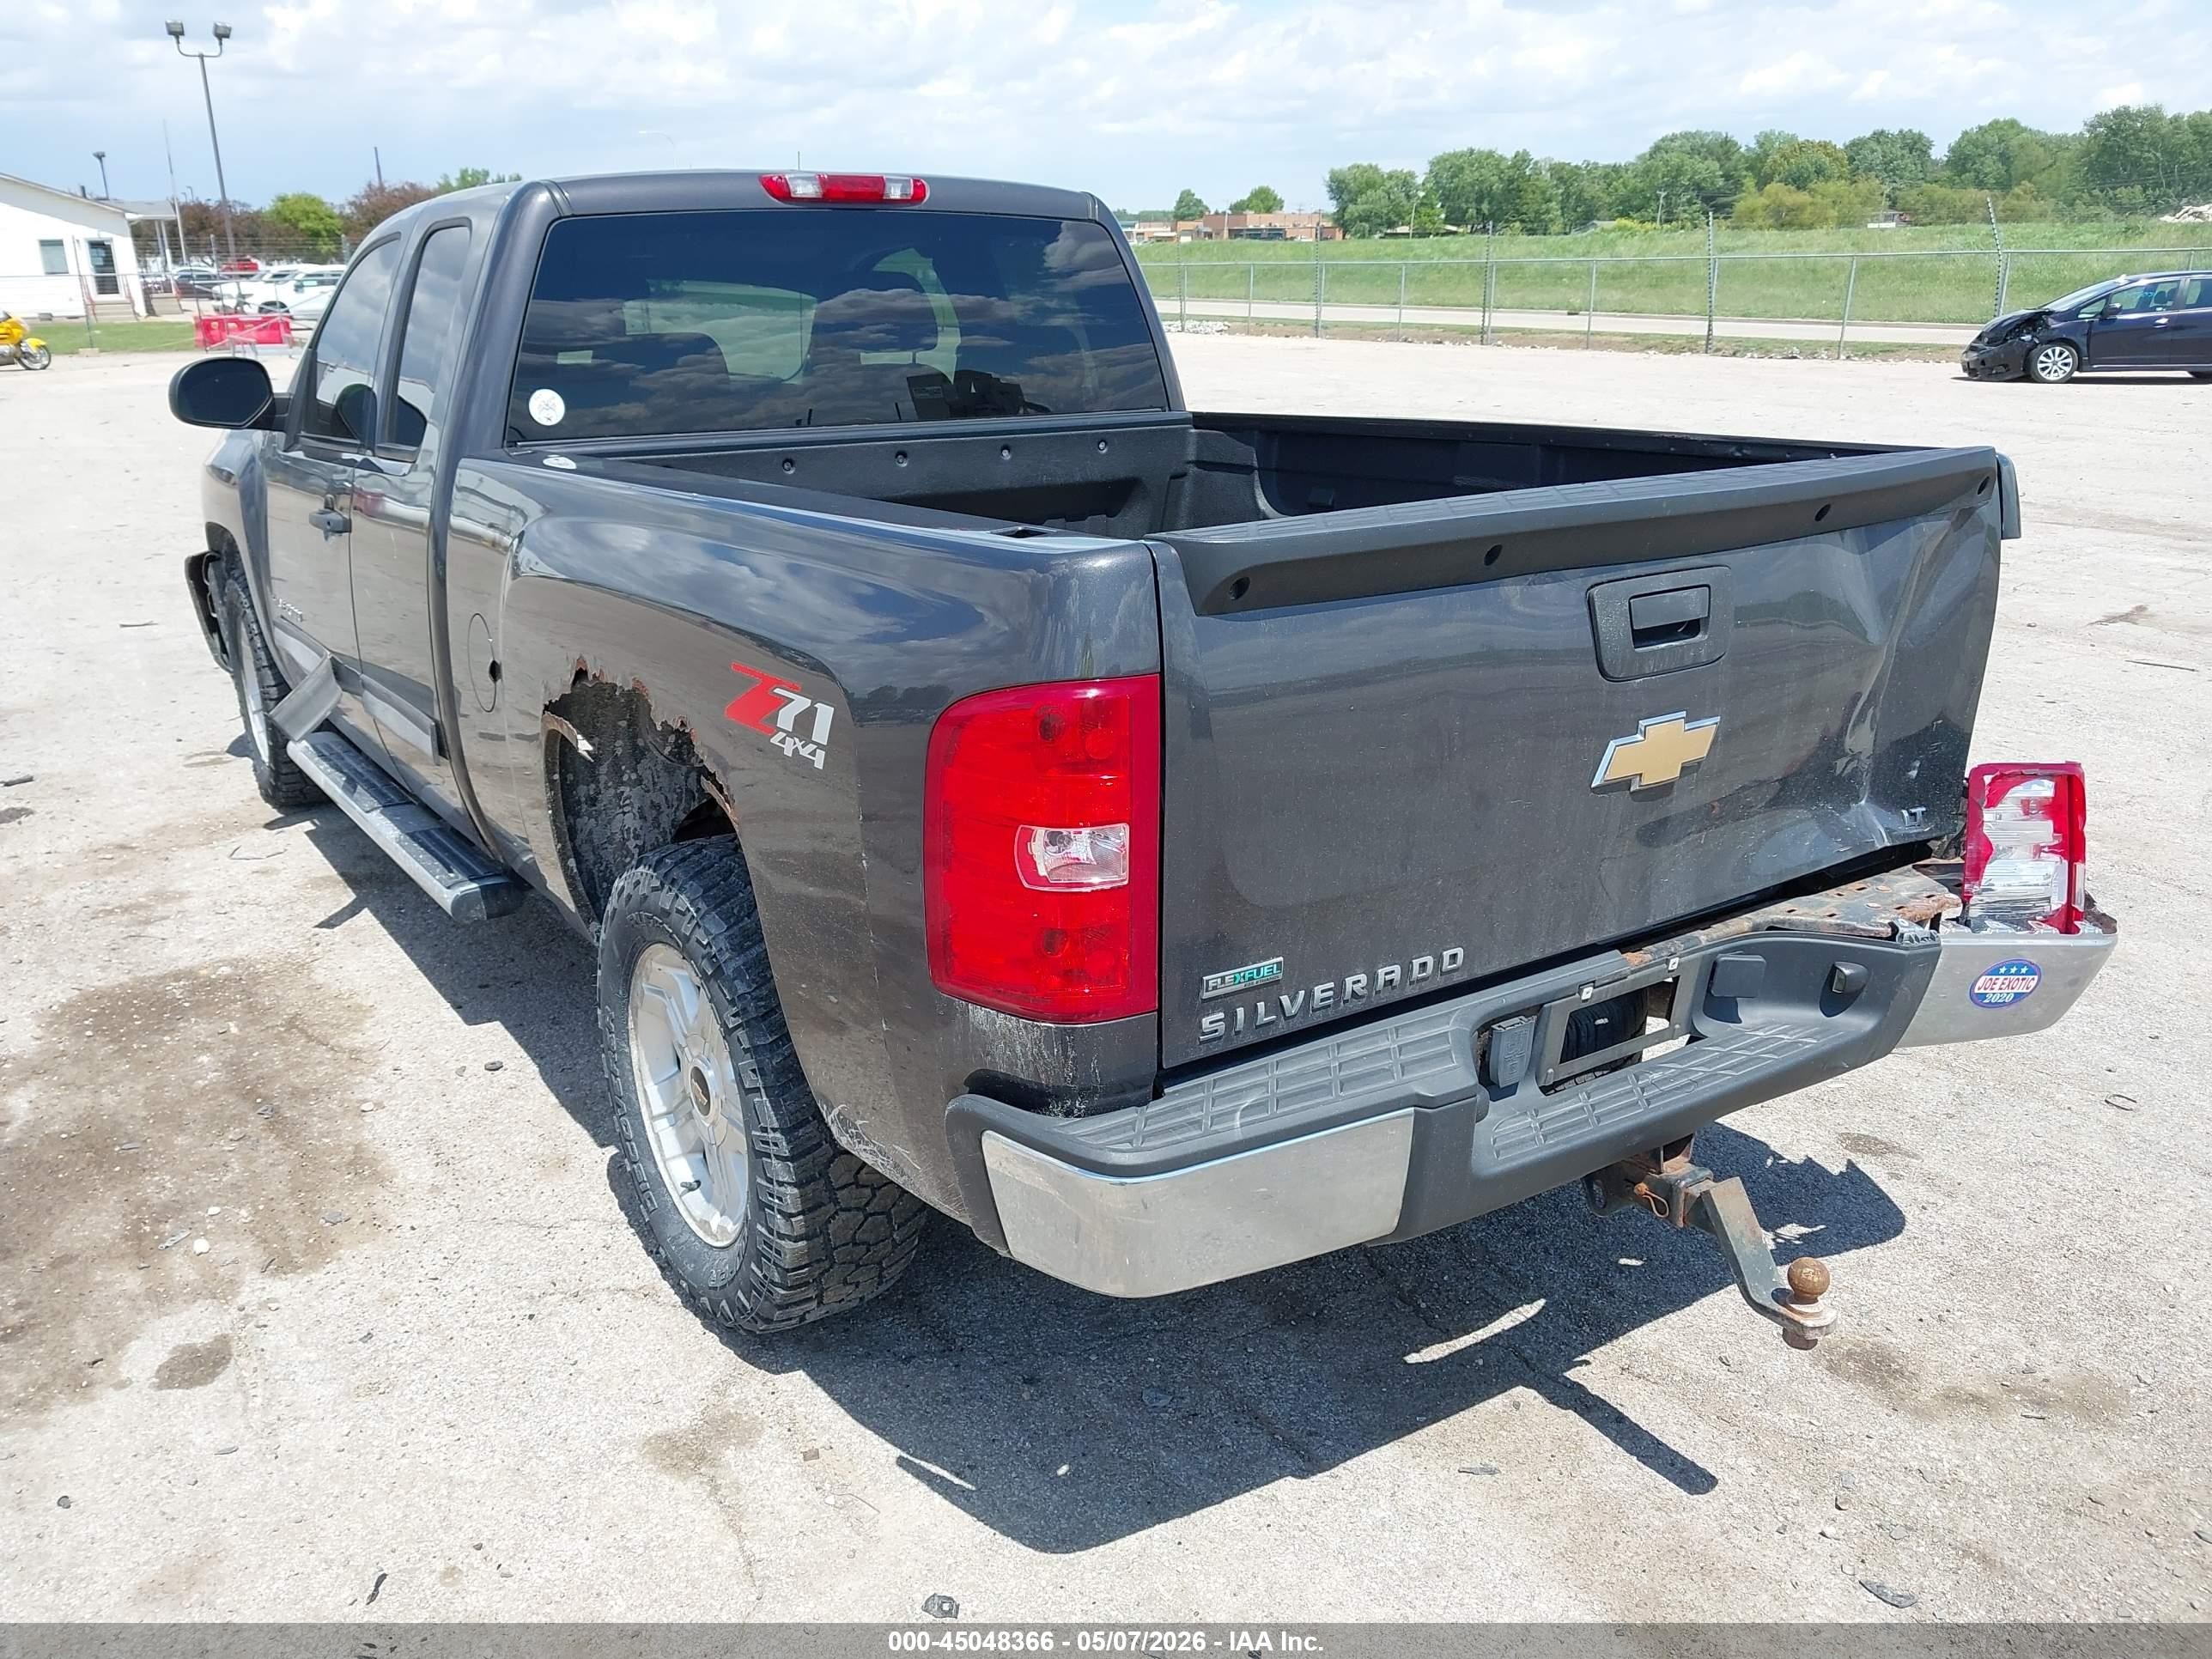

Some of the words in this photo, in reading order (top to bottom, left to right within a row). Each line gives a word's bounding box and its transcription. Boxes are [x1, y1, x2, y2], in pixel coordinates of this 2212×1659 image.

[724, 661, 835, 745] Z71
[1900, 807, 1927, 827] LT
[1207, 963, 1281, 991] FLEXFUEL
[1978, 977, 2000, 991] JOE
[1998, 977, 2035, 991] EXOTIC
[1199, 947, 1465, 1041] SILVERADO
[1983, 993, 2014, 1003] 2020
